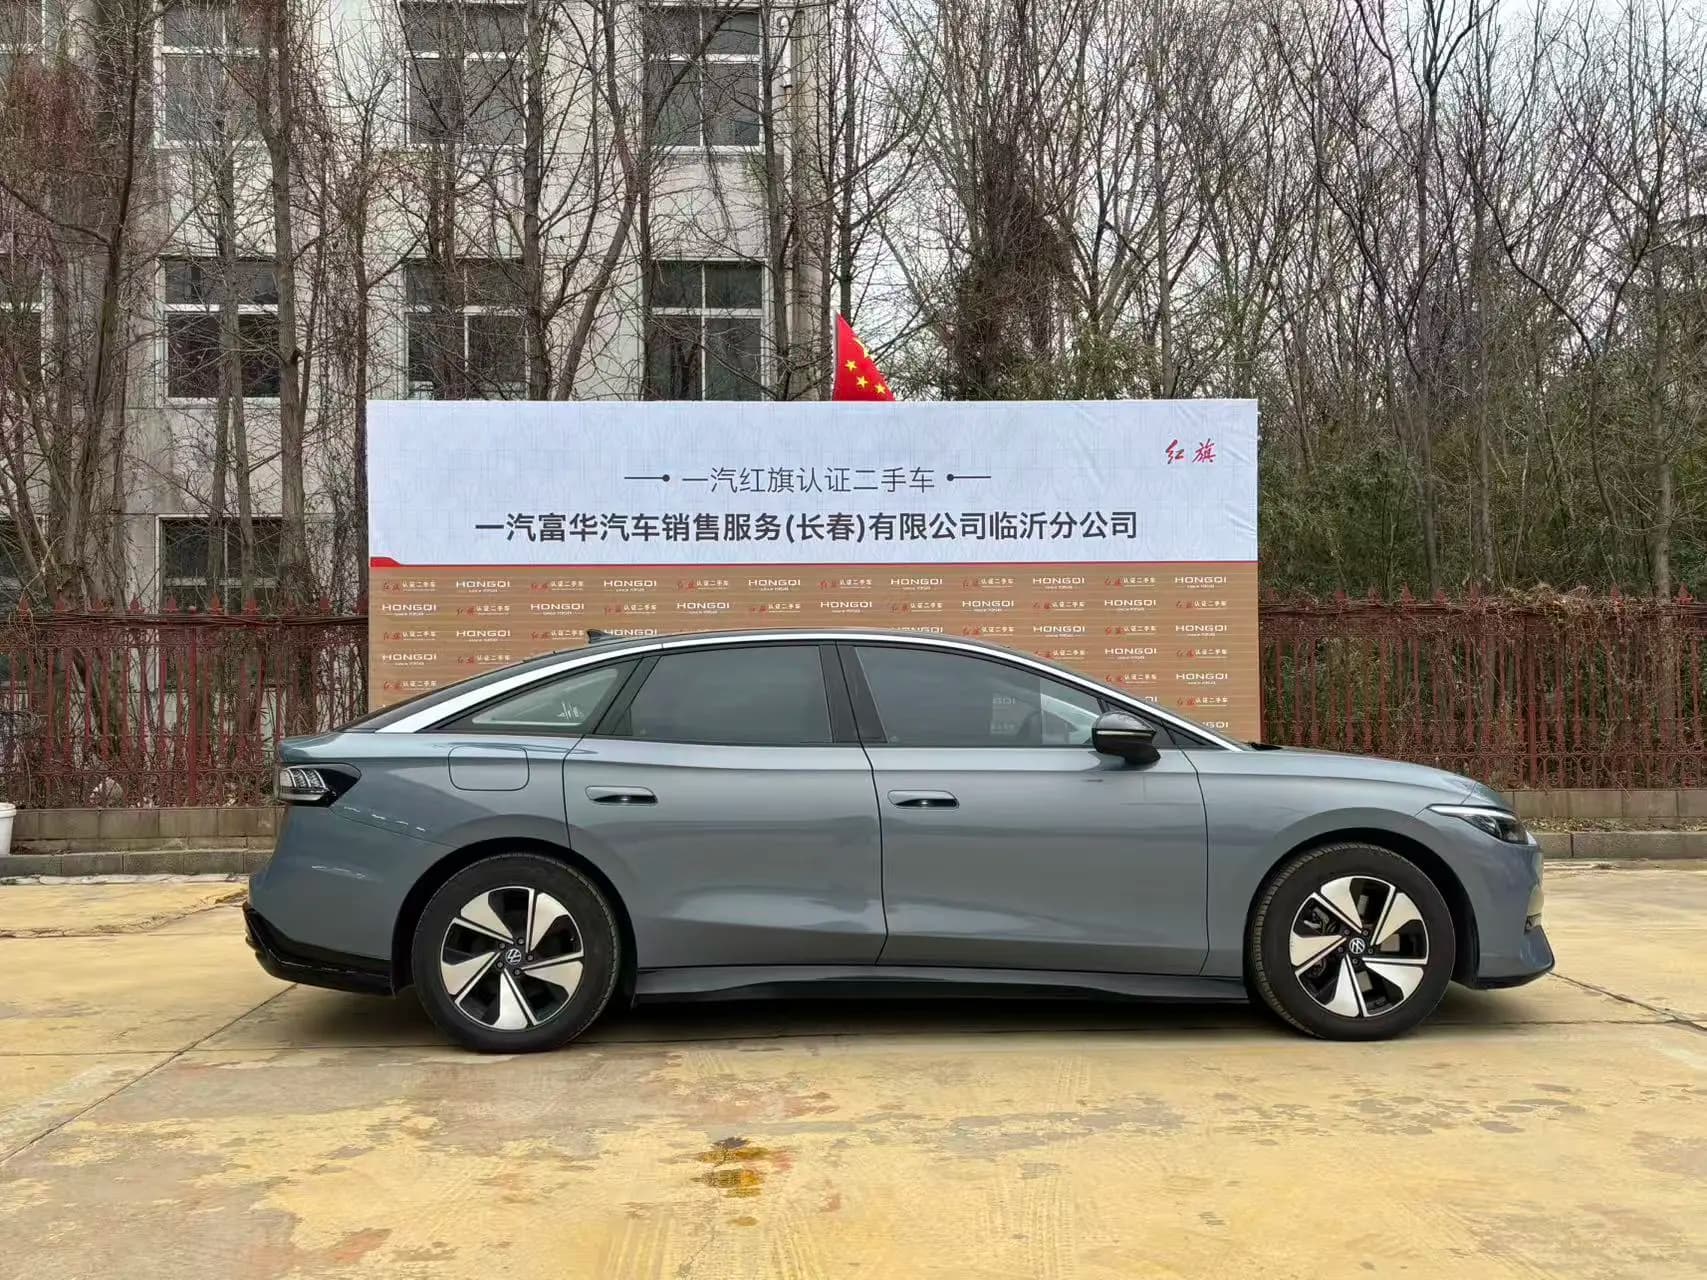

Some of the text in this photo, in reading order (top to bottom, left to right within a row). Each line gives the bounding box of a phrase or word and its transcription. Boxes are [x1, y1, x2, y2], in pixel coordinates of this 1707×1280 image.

[1164, 438, 1217, 465] 红旗
[682, 466, 935, 494] 一汽红旗认证二手车
[475, 511, 1137, 542] 一汽富华汽车销售服务(长春)有限公司临沂分公司
[1104, 599, 1157, 607] HONGQI
[455, 629, 511, 637] HONGQI
[382, 653, 437, 661] HONGQI
